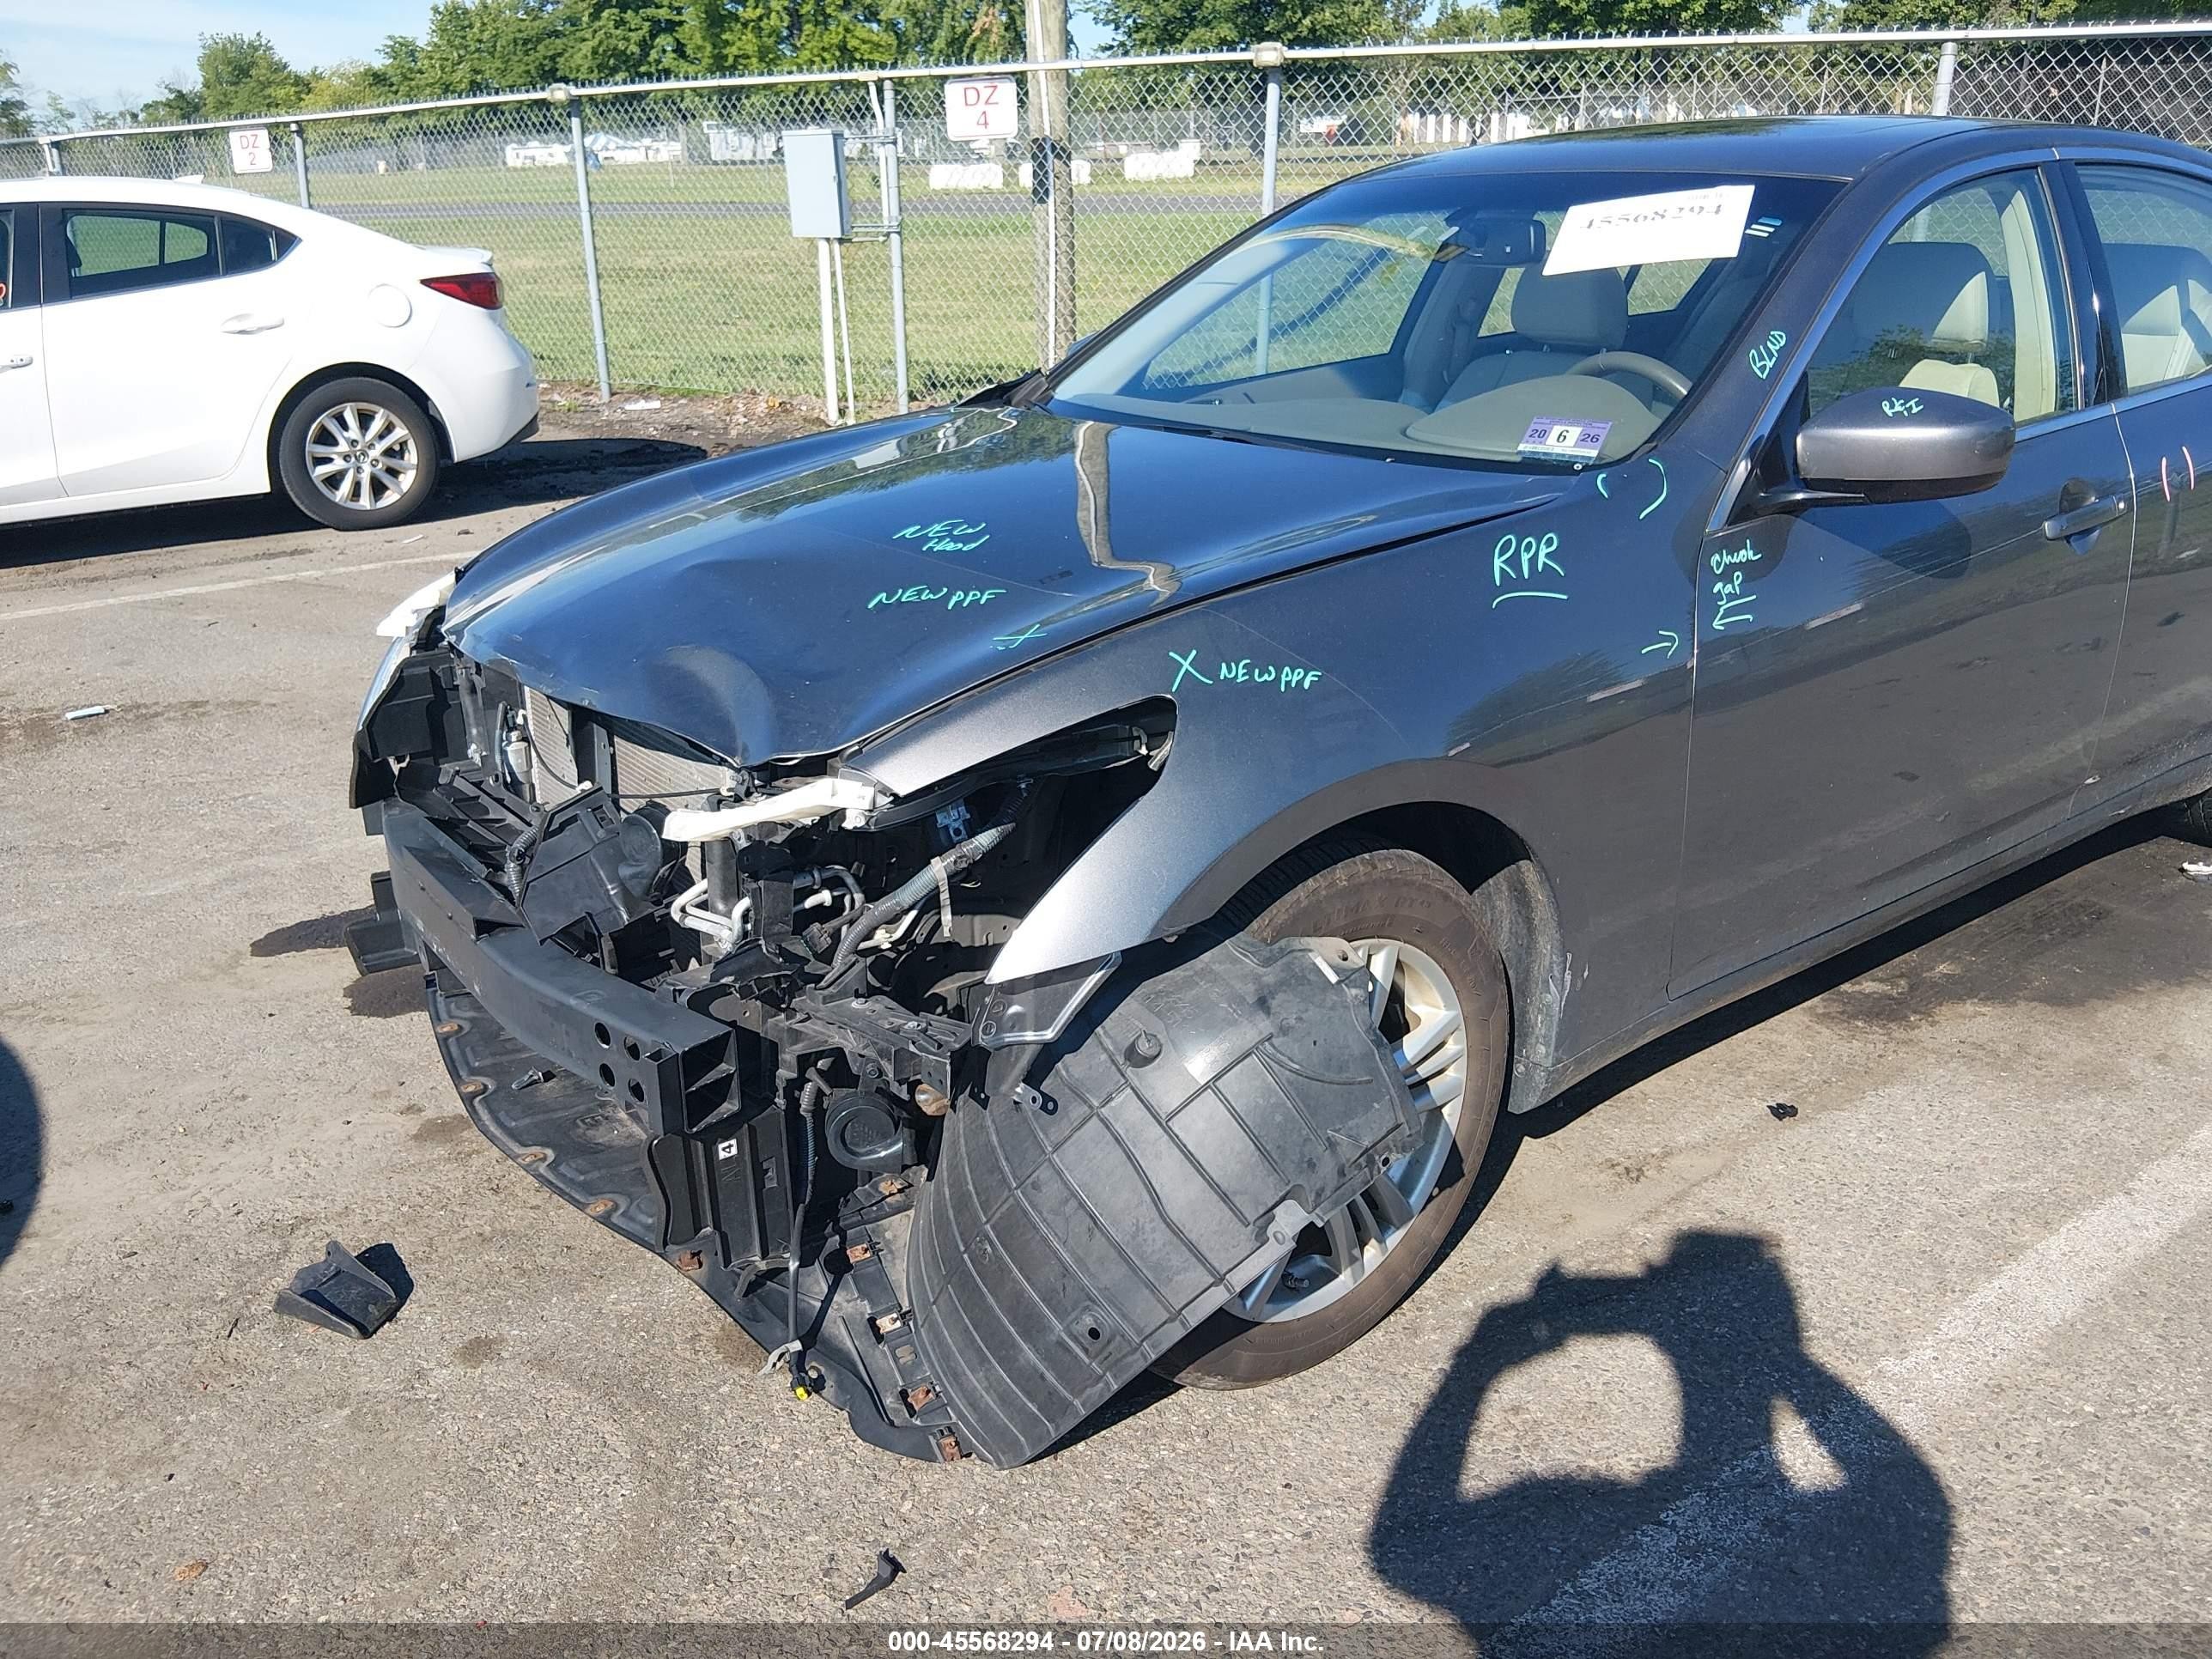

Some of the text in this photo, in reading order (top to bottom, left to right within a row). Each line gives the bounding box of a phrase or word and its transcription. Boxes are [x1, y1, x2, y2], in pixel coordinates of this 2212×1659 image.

[963, 84, 1000, 107] DZ
[976, 110, 990, 130] 4
[240, 134, 260, 149] DZ
[248, 151, 257, 166] 2
[1748, 330, 1787, 380] BLND
[1528, 428, 1601, 444] 20 6 26
[892, 519, 987, 540] NEW
[1492, 532, 1565, 587] RPR
[721, 1142, 734, 1154] 4
